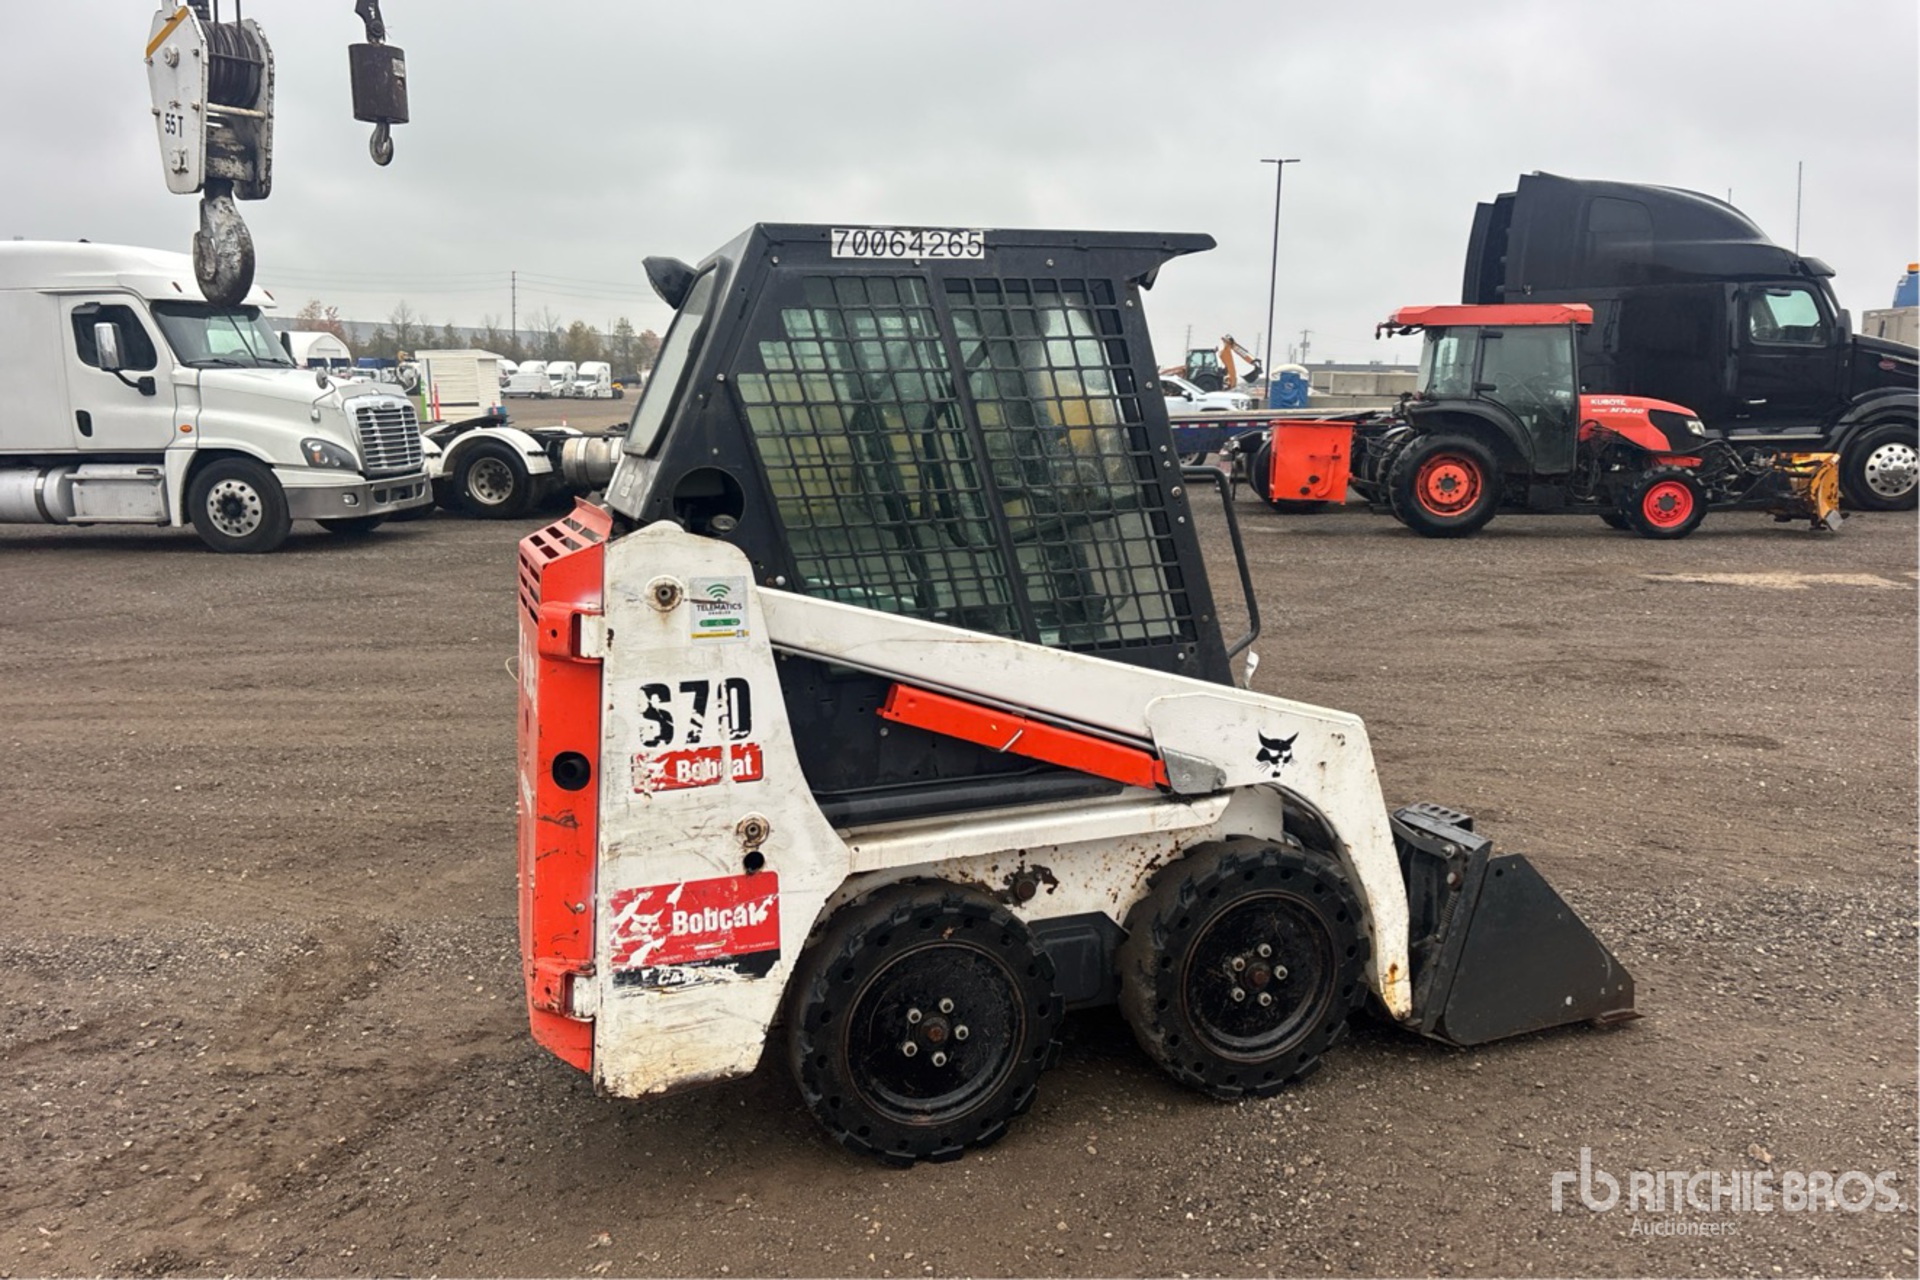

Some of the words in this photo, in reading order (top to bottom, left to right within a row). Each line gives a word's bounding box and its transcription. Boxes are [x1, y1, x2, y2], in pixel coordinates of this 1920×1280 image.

[833, 230, 983, 258] 70064265
[696, 602, 743, 612] TELEMATICS
[676, 753, 753, 783] Bobat
[672, 900, 767, 936] Bobcat
